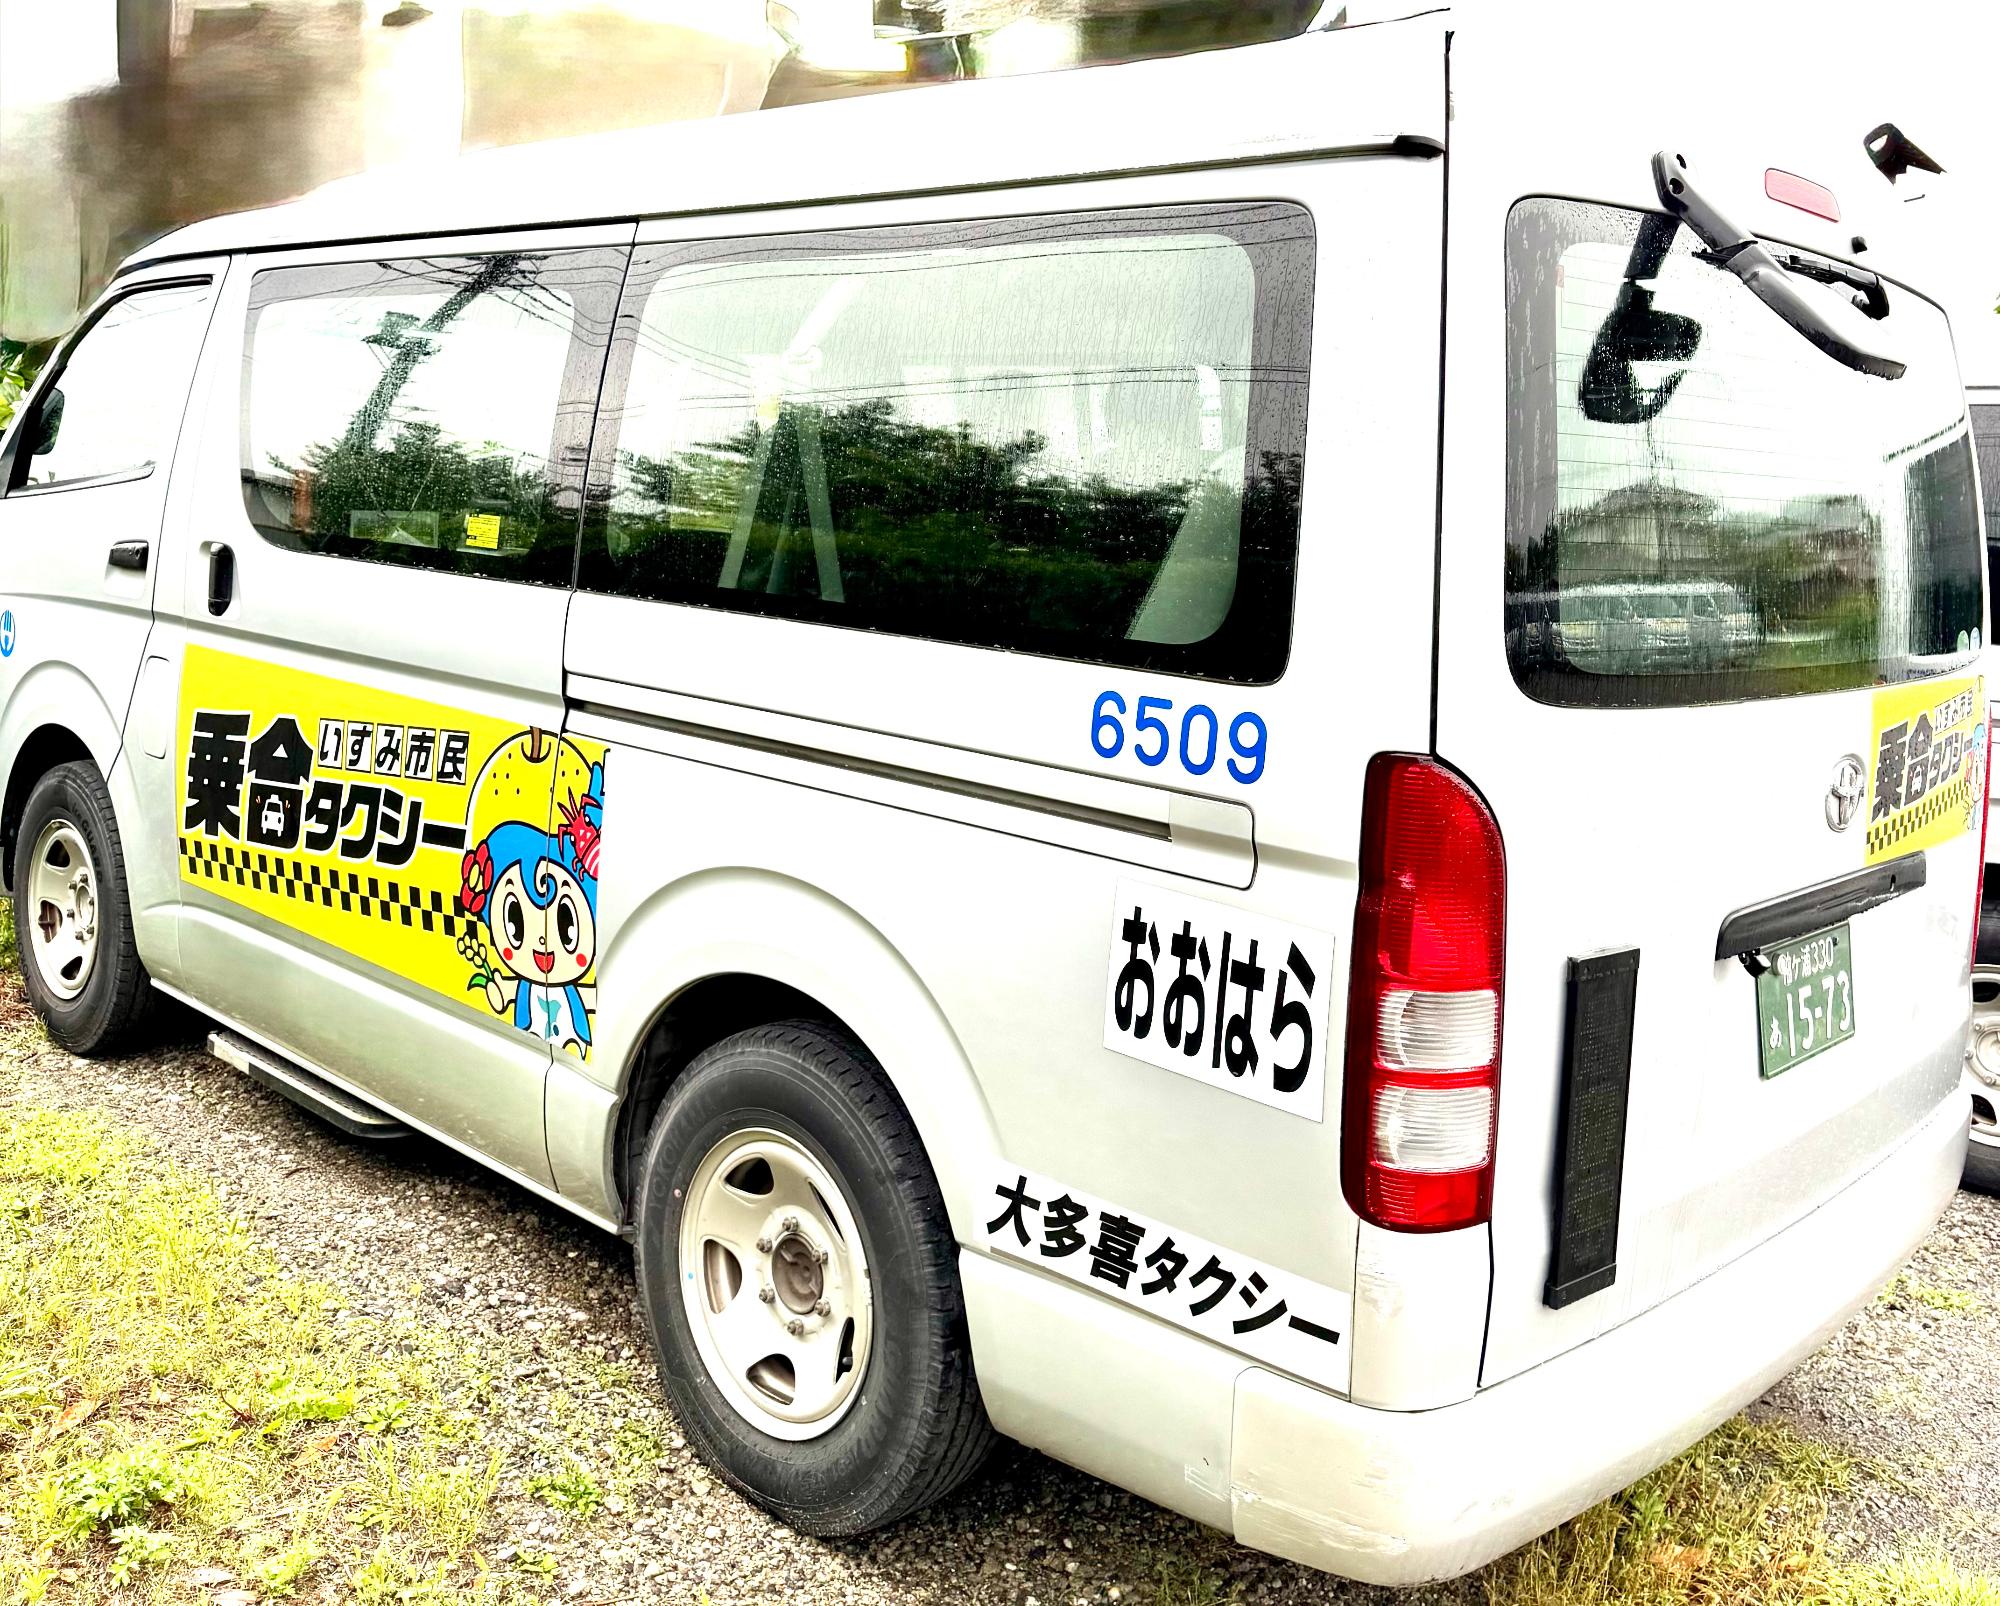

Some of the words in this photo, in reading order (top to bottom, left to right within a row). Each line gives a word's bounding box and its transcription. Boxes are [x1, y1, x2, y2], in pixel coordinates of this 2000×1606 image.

[185, 712, 467, 864] 乗合タクシー
[318, 718, 470, 784] いすみ市民
[1091, 691, 1267, 784] 6509
[1115, 906, 1316, 1093] おおはら
[1786, 970, 1850, 1057] 15-73
[986, 1175, 1341, 1345] 大多喜タクシー
